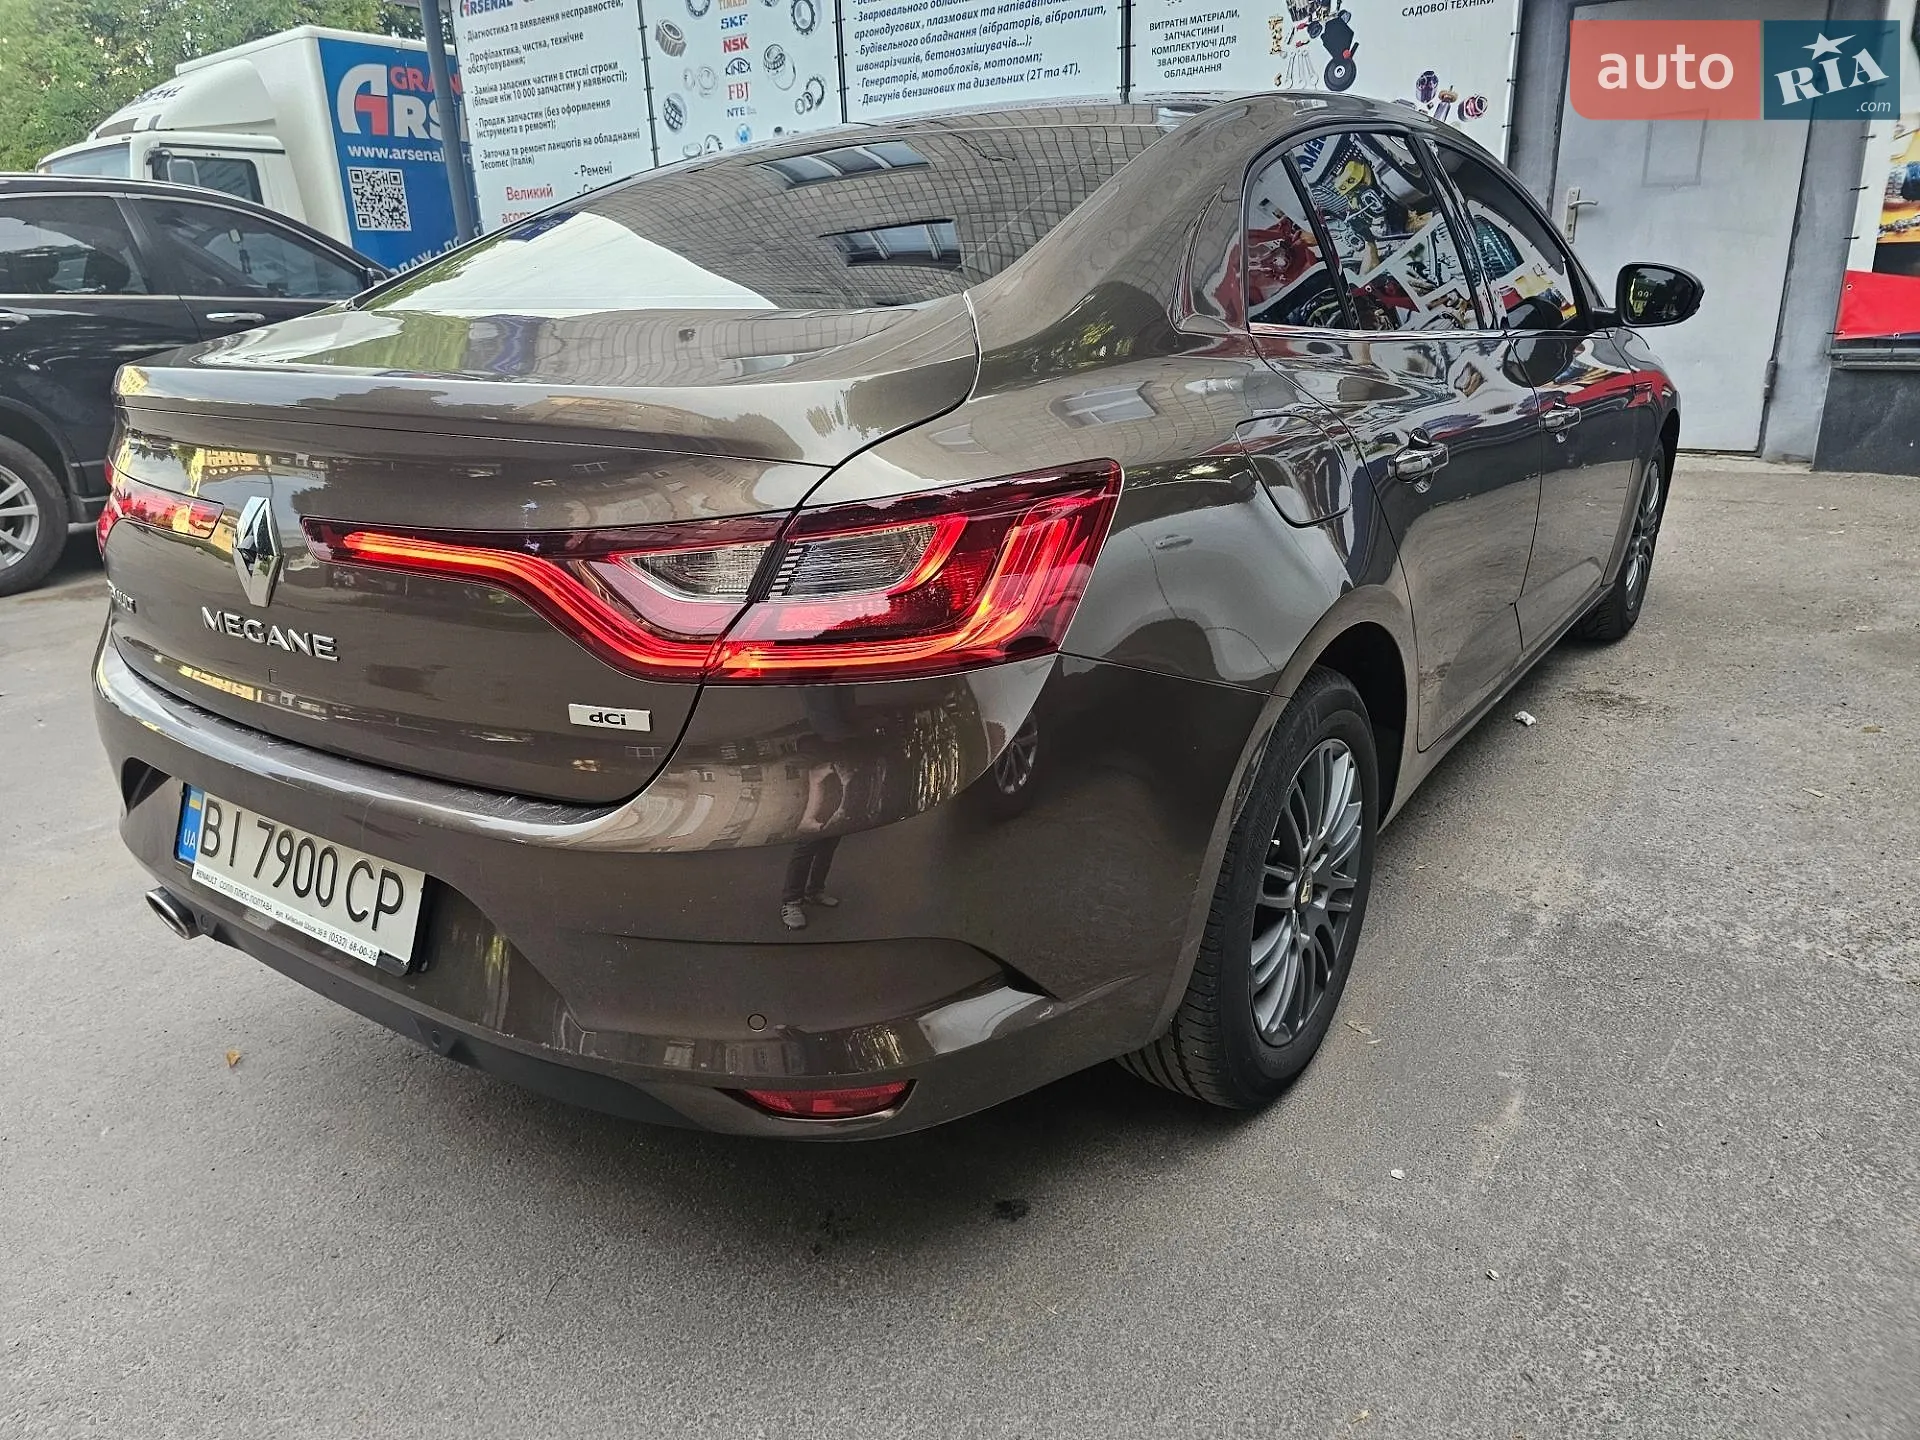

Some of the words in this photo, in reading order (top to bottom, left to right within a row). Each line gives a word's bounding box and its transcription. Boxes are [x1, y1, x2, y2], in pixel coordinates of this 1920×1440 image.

[858, 2, 928, 22] Зварювального
[927, 9, 978, 27] плазмових
[980, 7, 995, 17] та
[1402, 0, 1447, 17] САДОВОЇ
[468, 25, 509, 42] Діагностика
[511, 22, 518, 31] та
[520, 13, 560, 29] виявлення
[721, 14, 748, 30] SKF
[860, 37, 918, 55] Будівельного
[920, 27, 977, 45] обладнання
[979, 15, 1042, 36] (вібраторів,
[1045, 5, 1106, 24] віброплит,
[1149, 18, 1188, 31] ВИТРАТНІ
[1189, 9, 1240, 24] МАТЕРІАЛИ,
[1164, 25, 1220, 41] ЗАПЧАСТИНИ
[469, 46, 521, 63] Профілактика,
[522, 40, 549, 52] чистка,
[551, 31, 584, 46] технічне
[723, 37, 749, 53] NSK
[1151, 38, 1217, 56] КОМПЛЕКТУЮЧІ
[1218, 35, 1237, 47] ДЛЯ
[468, 57, 526, 74] обслуговування;
[856, 52, 922, 72] швонарізчиків,
[1157, 49, 1230, 67] ЗВАРЮВАЛЬНОГО
[474, 83, 498, 95] Заміна
[499, 79, 531, 91] запасних
[533, 73, 558, 84] частин
[565, 64, 589, 79] стислі
[590, 61, 618, 75] строки
[862, 70, 919, 88] Генераторів,
[921, 60, 981, 79] мотоблоків,
[984, 52, 1042, 70] мотопомп;
[1164, 63, 1222, 78] ОБЛАДНАННЯ
[500, 91, 512, 101] ніж
[537, 82, 575, 95] запчастин
[576, 80, 581, 91] у
[583, 70, 628, 87] наявності);
[728, 82, 748, 101] FBJ
[862, 89, 900, 105] Двигунів
[902, 82, 955, 98] бензинових
[957, 80, 971, 91] та
[973, 72, 1024, 88] дизельних
[1044, 67, 1060, 78] та
[478, 116, 505, 128] Продаж
[507, 110, 544, 122] запчастин
[544, 106, 559, 119] (без
[561, 99, 611, 117] оформлення
[727, 107, 745, 117] NTE
[477, 125, 518, 139] інструмента
[483, 149, 510, 159] Заточка
[520, 143, 546, 156] ремонт
[548, 137, 581, 152] ланцюгів
[583, 137, 592, 145] на
[594, 128, 640, 144] обладнанні
[580, 161, 612, 177] Ремені
[506, 183, 553, 200] Великий
[202, 606, 340, 662] MEGANE
[589, 712, 626, 725] dCi
[183, 828, 196, 849] UA
[200, 799, 241, 867] BI
[253, 819, 338, 907] 7900
[346, 859, 404, 931] CP
[196, 868, 217, 884] RENAULT
